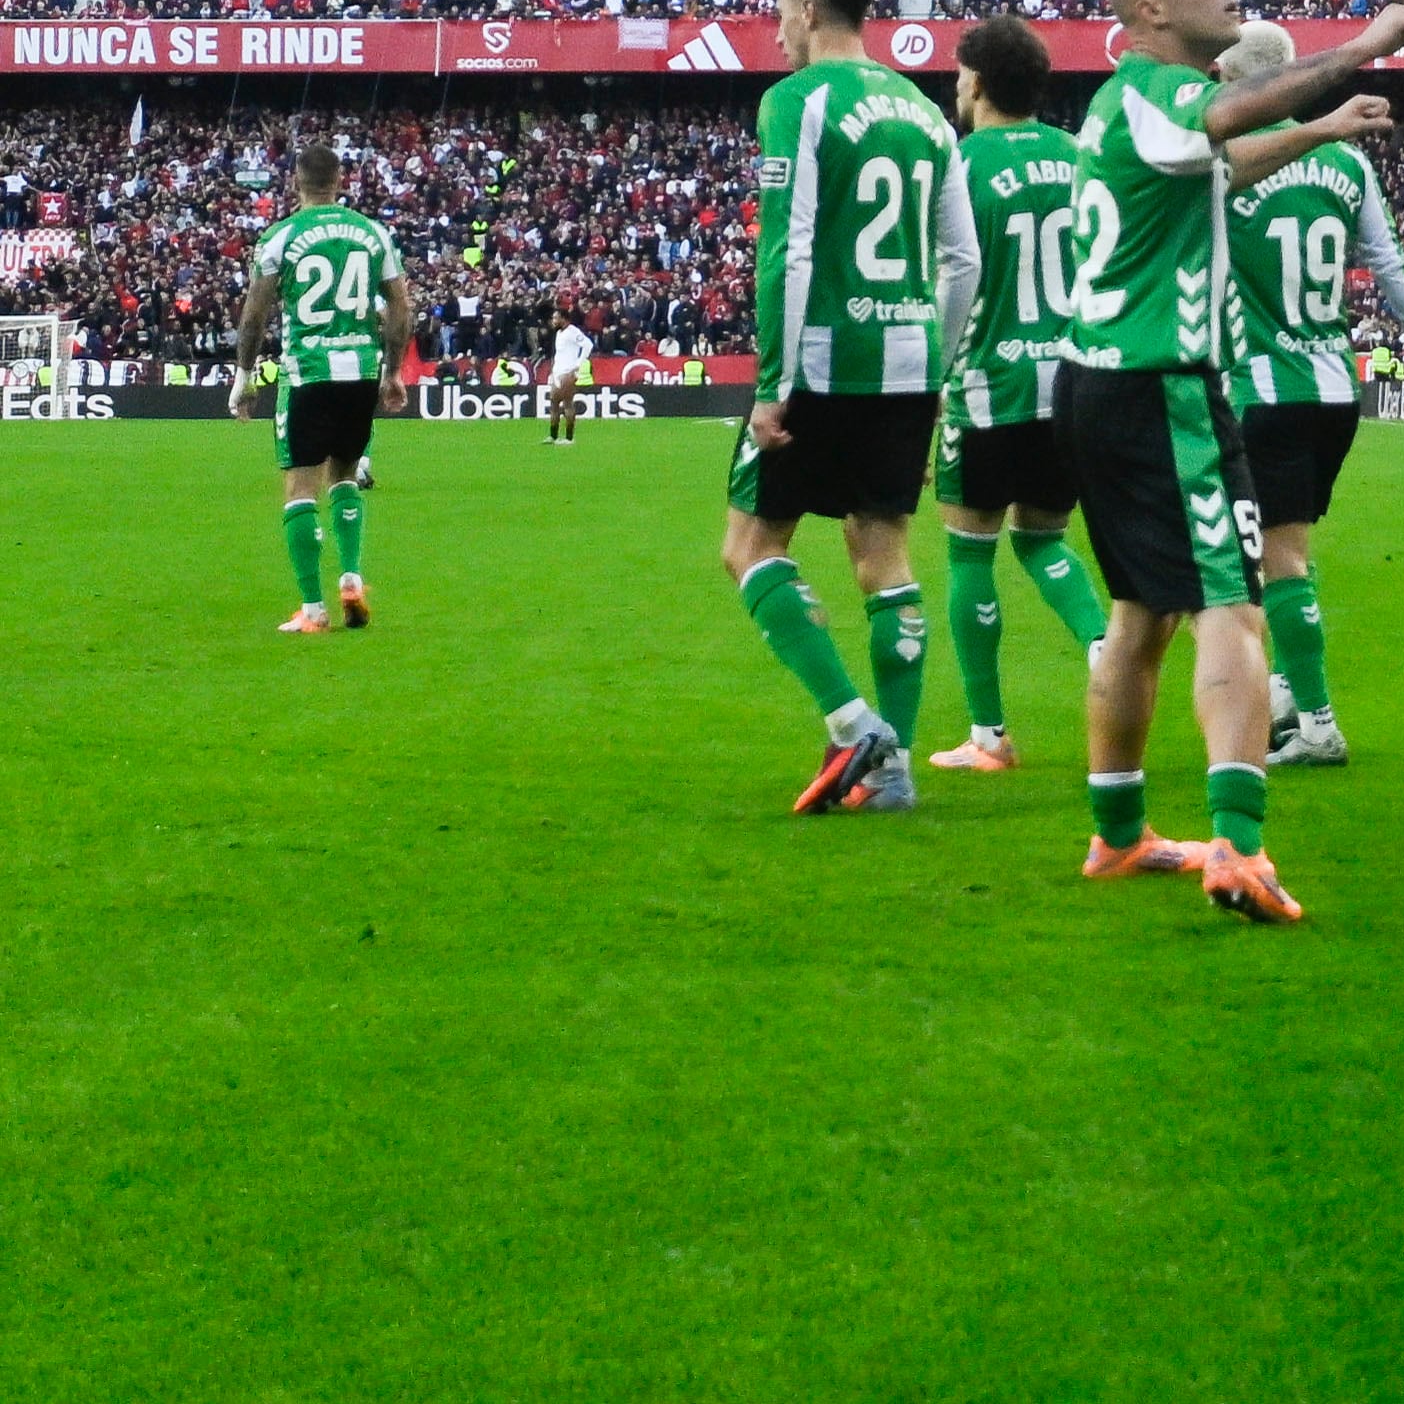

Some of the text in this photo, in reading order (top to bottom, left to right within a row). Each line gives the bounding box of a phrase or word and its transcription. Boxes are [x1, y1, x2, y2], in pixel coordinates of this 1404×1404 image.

[14, 27, 364, 65] NUNCA SE RINDE
[897, 35, 927, 55] JD
[1025, 159, 1076, 185] ABD
[856, 155, 933, 282] 21
[1070, 178, 1127, 323] 2
[296, 250, 370, 326] 24
[1005, 206, 1074, 323] 10
[1265, 215, 1347, 327] 19
[419, 384, 529, 420] Uber
